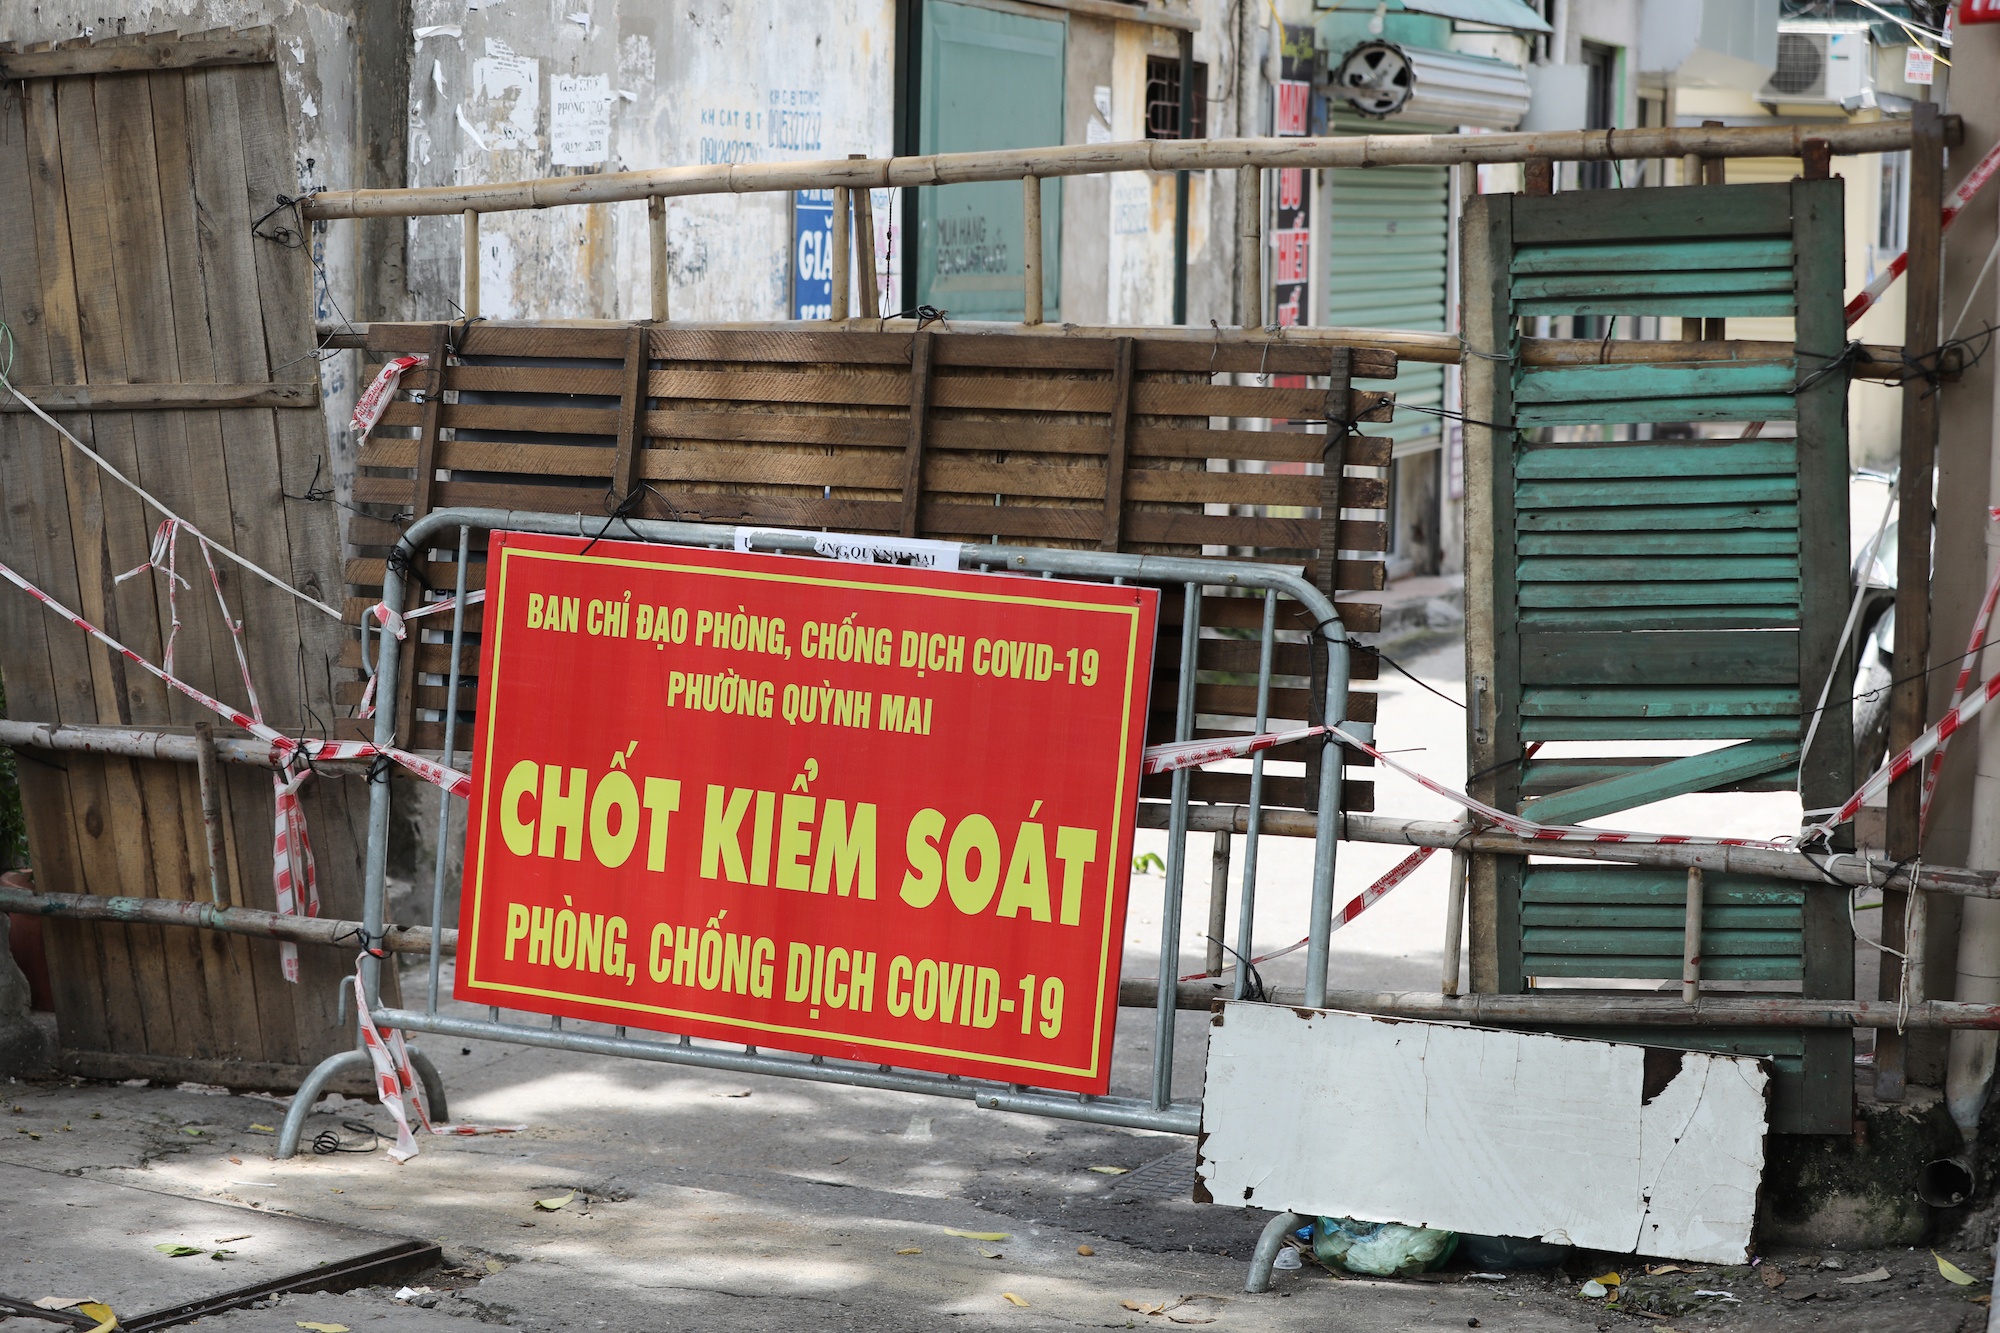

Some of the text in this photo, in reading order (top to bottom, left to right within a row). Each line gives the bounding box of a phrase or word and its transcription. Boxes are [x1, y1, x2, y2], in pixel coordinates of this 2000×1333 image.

[527, 590, 1099, 687] BAN CHỈ ĐẠO PHÒNG, CHỐNG DỊCH COVID-19
[667, 668, 932, 735] PHƯỜNG QUỲNH MAI
[500, 740, 1097, 926] CHỐT KIỂM SOÁT
[504, 895, 1065, 1039] PHÒNG, CHỐNG DỊCH COVID-19
